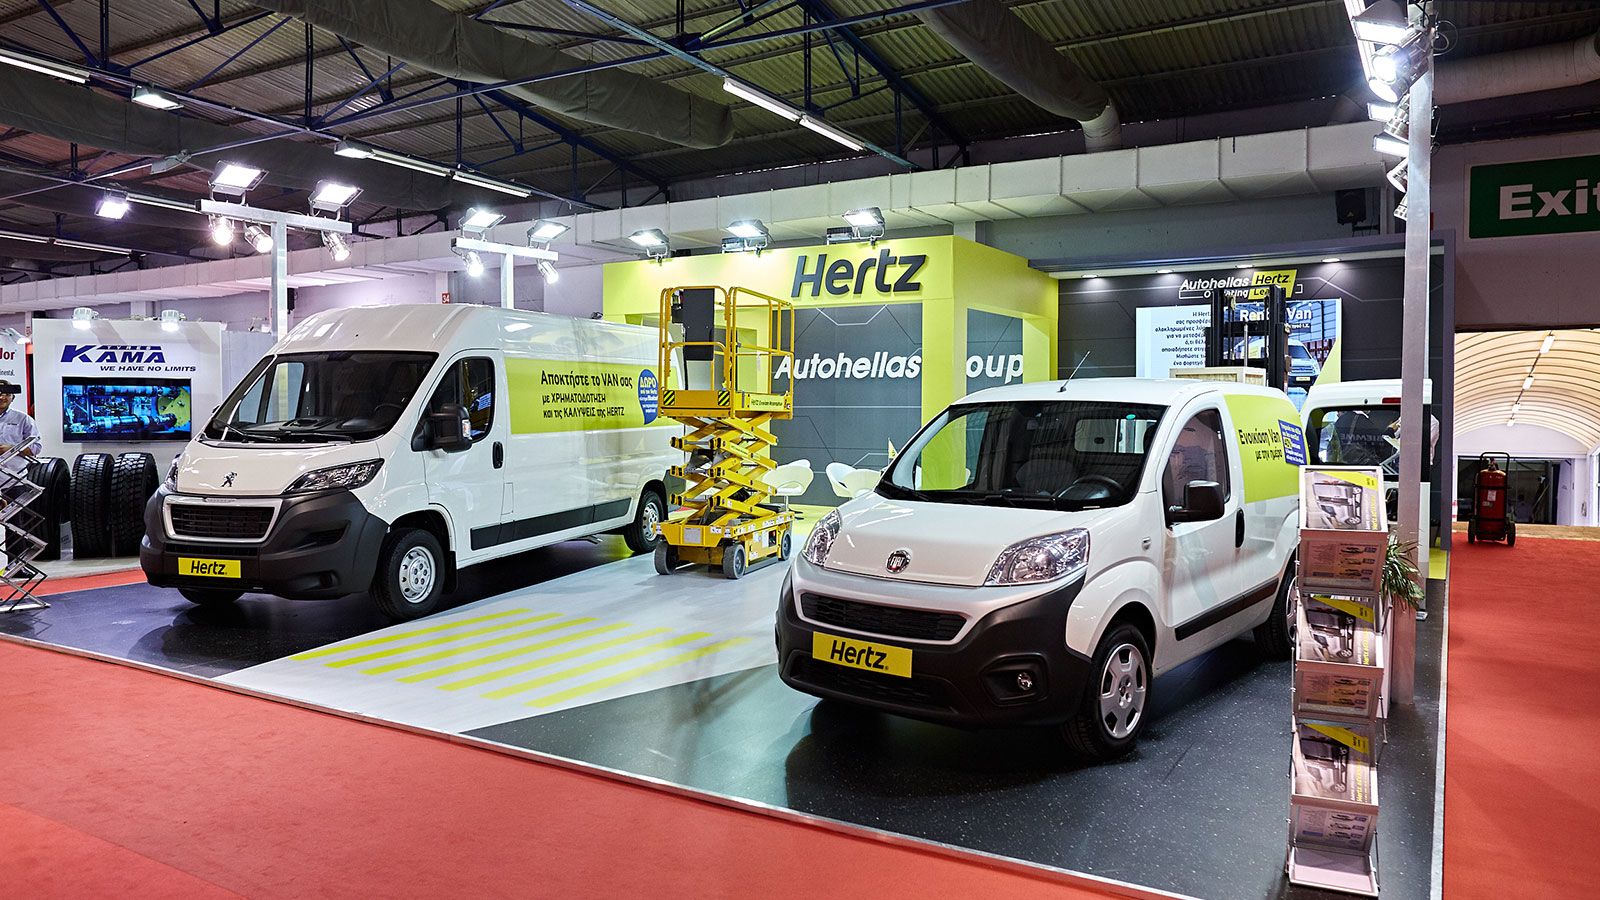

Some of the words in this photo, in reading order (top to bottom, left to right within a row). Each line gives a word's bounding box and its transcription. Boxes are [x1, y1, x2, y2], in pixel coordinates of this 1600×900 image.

[791, 249, 928, 298] Hertz
[1180, 277, 1250, 291] Autohellas
[1255, 273, 1291, 285] Hertz
[443, 294, 450, 303] 34
[1286, 307, 1312, 321] Van
[61, 345, 166, 364] KAMA
[774, 351, 923, 381] Autohellas
[966, 352, 1024, 386] oup
[541, 370, 589, 388] Αποκτήστε
[591, 375, 600, 386] το
[601, 373, 619, 387] VAN
[620, 376, 633, 389] σας
[542, 395, 550, 404] με
[551, 393, 606, 403] ΧΡΗΜΑΤΟΔΟΤΗΣΗ
[543, 409, 553, 418] και
[554, 409, 563, 419] τις
[563, 407, 596, 418] ΚΑΛΥΨΕΙΣ
[597, 408, 606, 418] της
[607, 407, 624, 416] HERTZ
[1238, 428, 1270, 446] Ενοικίαση
[1268, 428, 1281, 443] Van
[191, 560, 226, 575] Hertz
